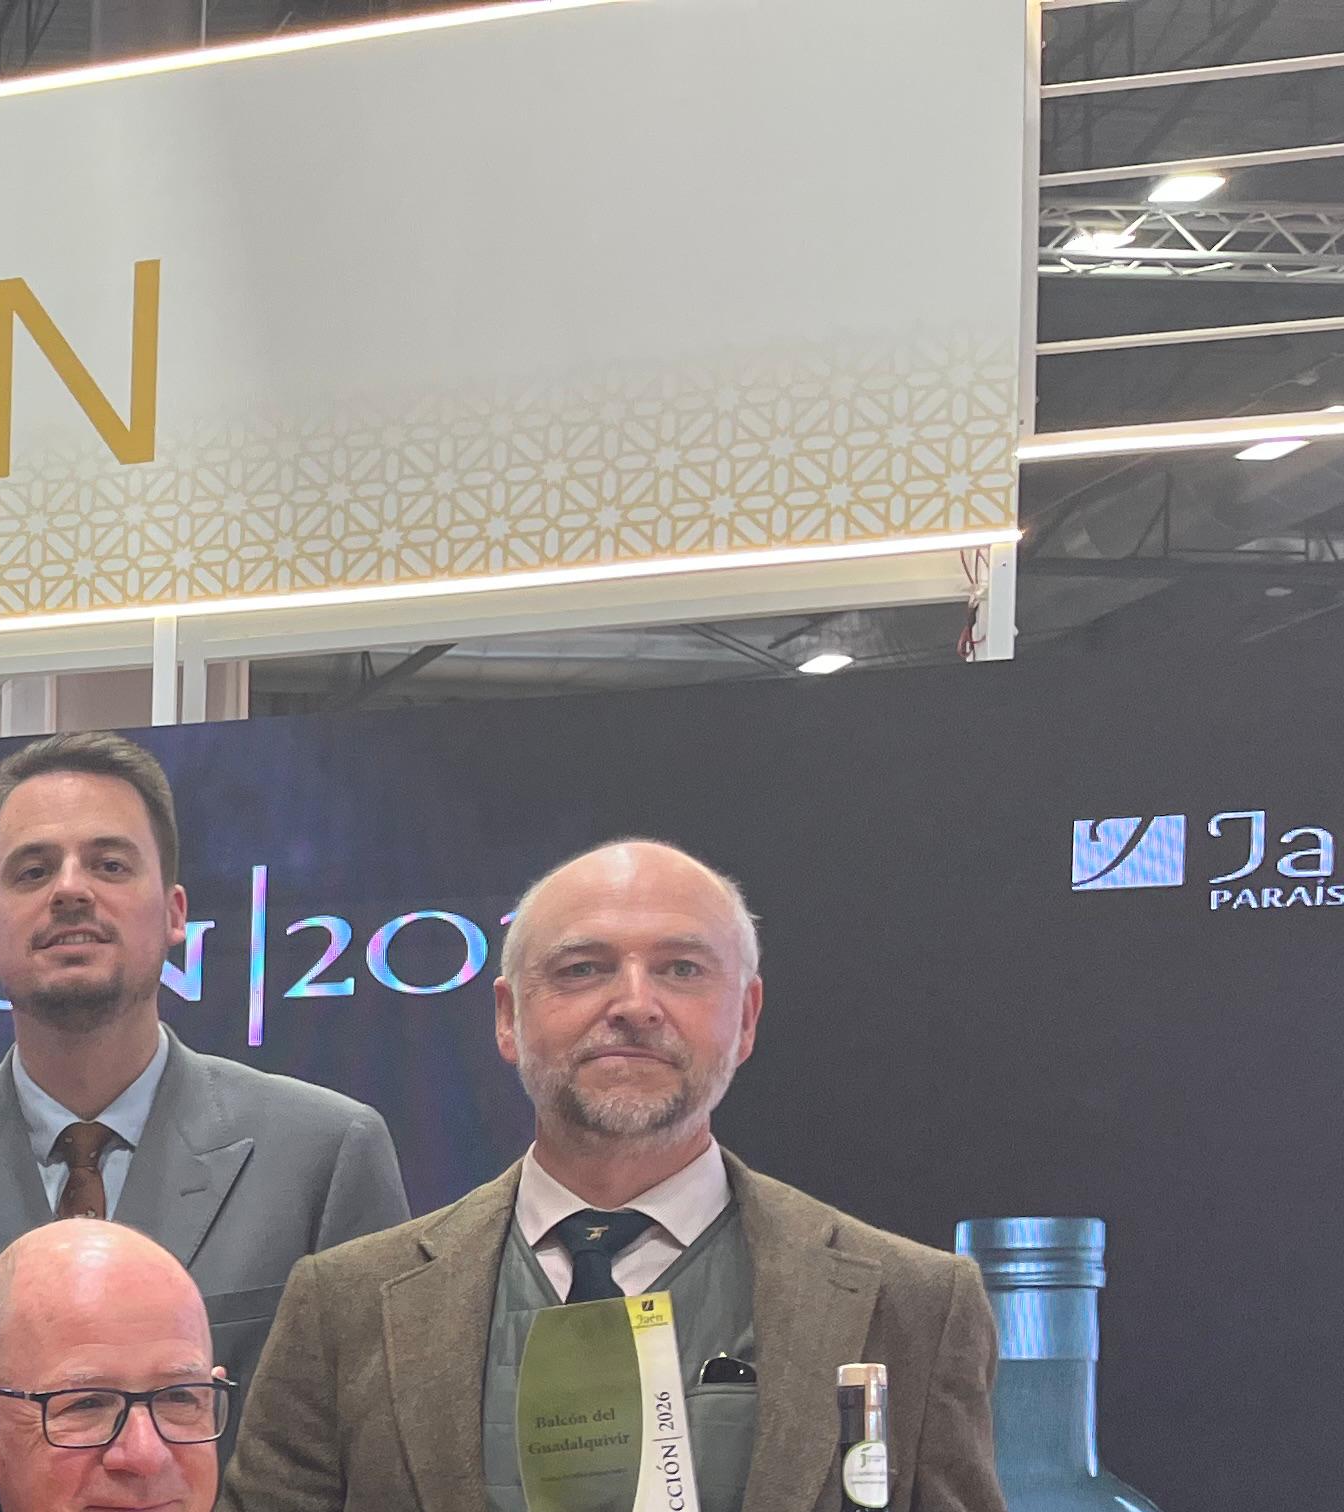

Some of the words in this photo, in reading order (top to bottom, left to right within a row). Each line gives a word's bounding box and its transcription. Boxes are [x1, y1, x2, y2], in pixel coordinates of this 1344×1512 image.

[1208, 809, 1335, 883] Ja
[536, 1412, 588, 1428] Balcón
[593, 1408, 614, 1422] del
[656, 1391, 675, 1432] 2026
[529, 1431, 629, 1454] Guadalquivir
